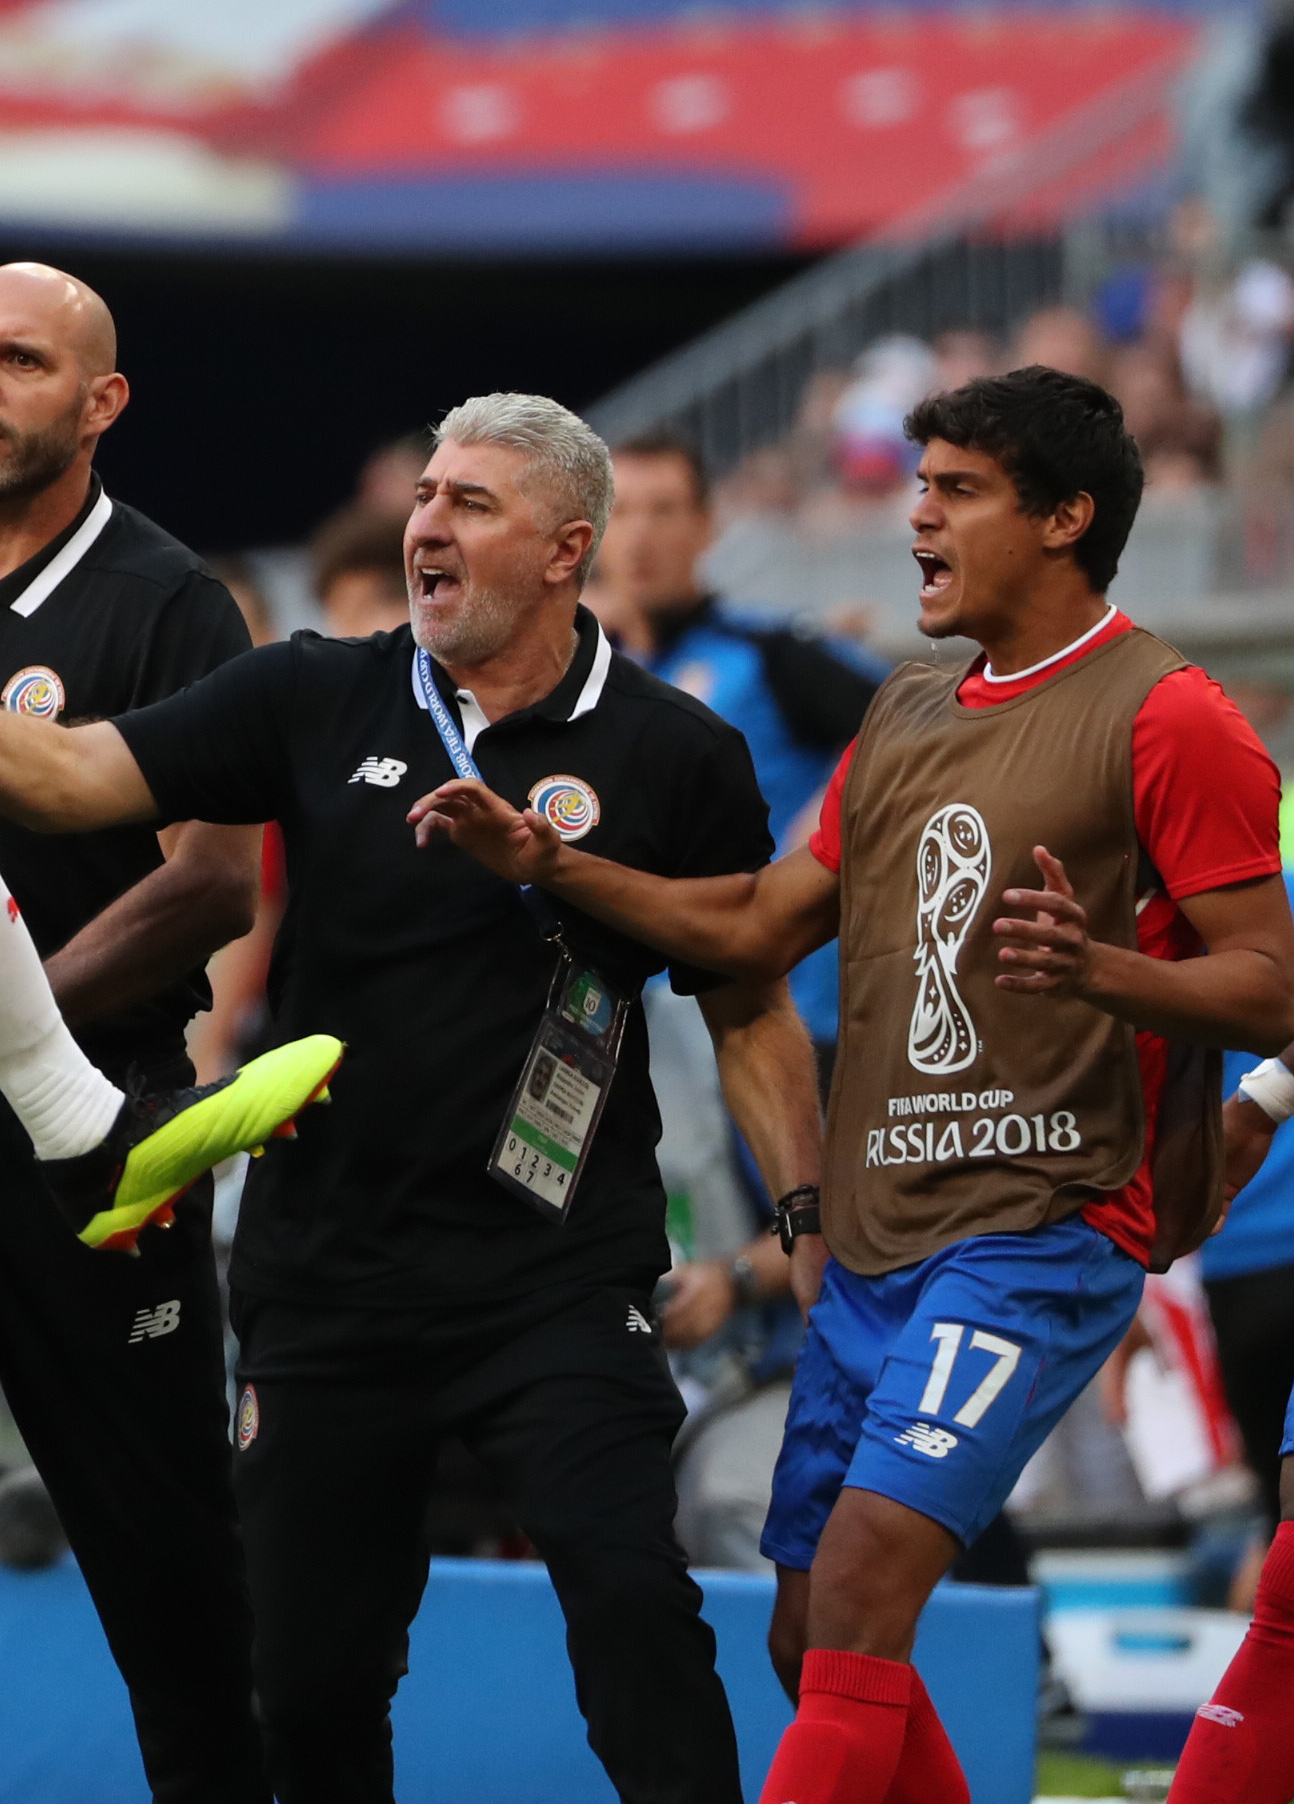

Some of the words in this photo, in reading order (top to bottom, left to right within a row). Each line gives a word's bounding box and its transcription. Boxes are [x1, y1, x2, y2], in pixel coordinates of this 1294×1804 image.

[419, 659, 429, 683] CUP
[425, 681, 449, 728] WORLD
[443, 725, 462, 754] FIFA
[912, 1092, 977, 1114] WORLD
[978, 1088, 1015, 1110] CUP
[866, 1121, 964, 1169] RUSSIA
[968, 1110, 1082, 1158] 2018
[509, 1138, 517, 1151] 0
[521, 1147, 528, 1160] 1
[531, 1155, 540, 1169] 2
[543, 1163, 552, 1177] 3
[556, 1173, 565, 1186] 4
[514, 1163, 522, 1176] 6
[526, 1170, 535, 1183] 7
[917, 1323, 1023, 1430] 17
